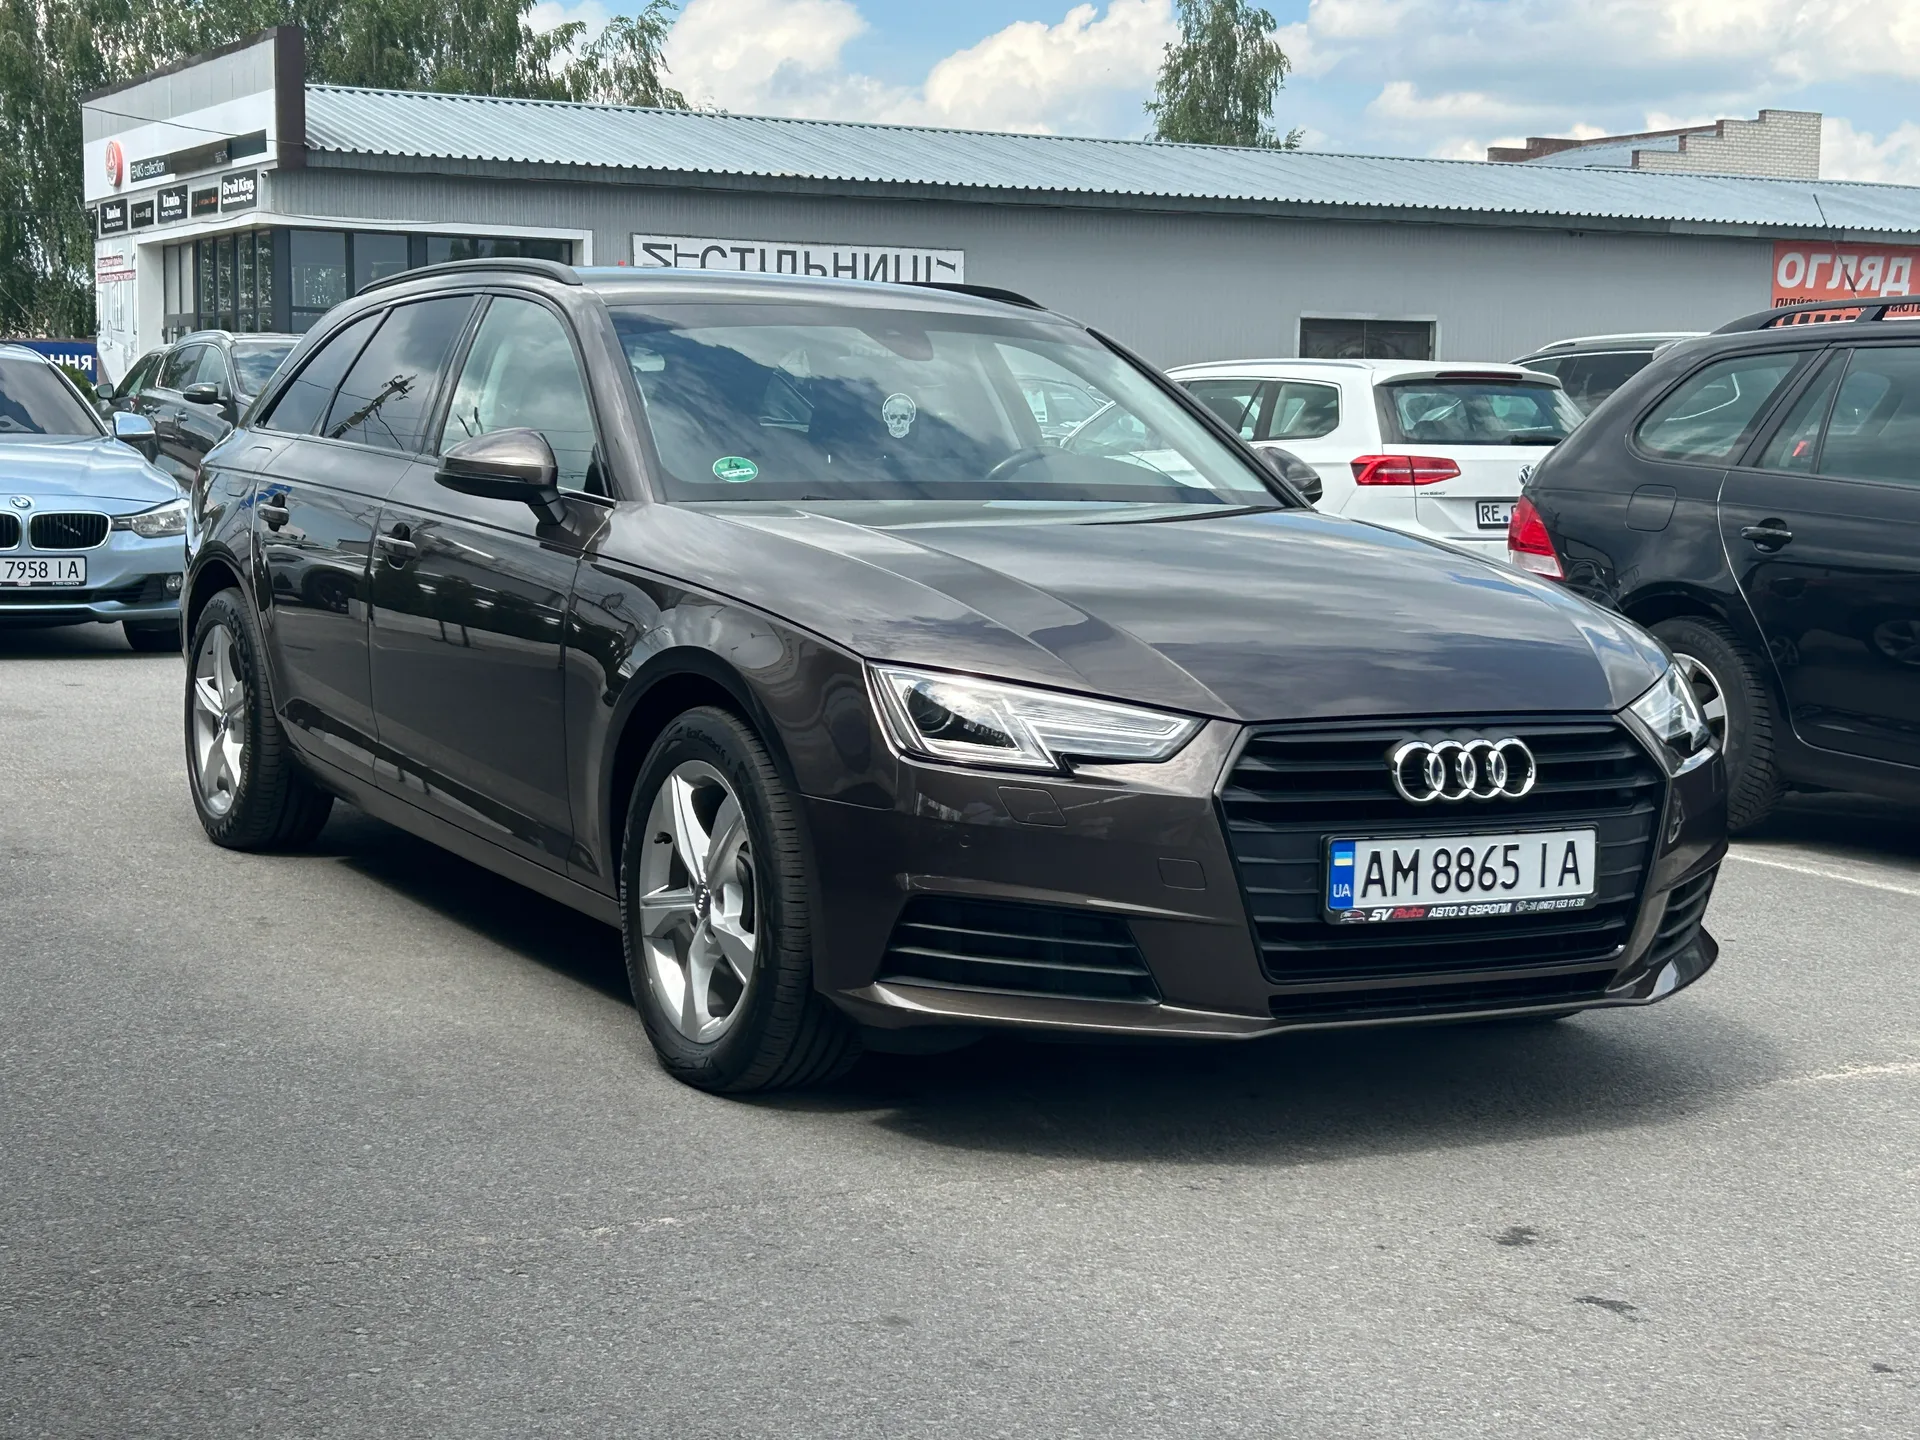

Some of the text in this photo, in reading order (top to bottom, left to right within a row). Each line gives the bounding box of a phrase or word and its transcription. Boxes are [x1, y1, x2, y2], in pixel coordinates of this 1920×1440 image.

[1777, 252, 1912, 297] ОГЛЯД
[1481, 505, 1501, 522] RE
[5, 561, 79, 579] 7958 IA
[1360, 840, 1581, 898] AM 8865 IA
[1333, 883, 1351, 898] UA
[1428, 905, 1459, 918] АВТО
[1468, 903, 1512, 916] ЄВРОПИ
